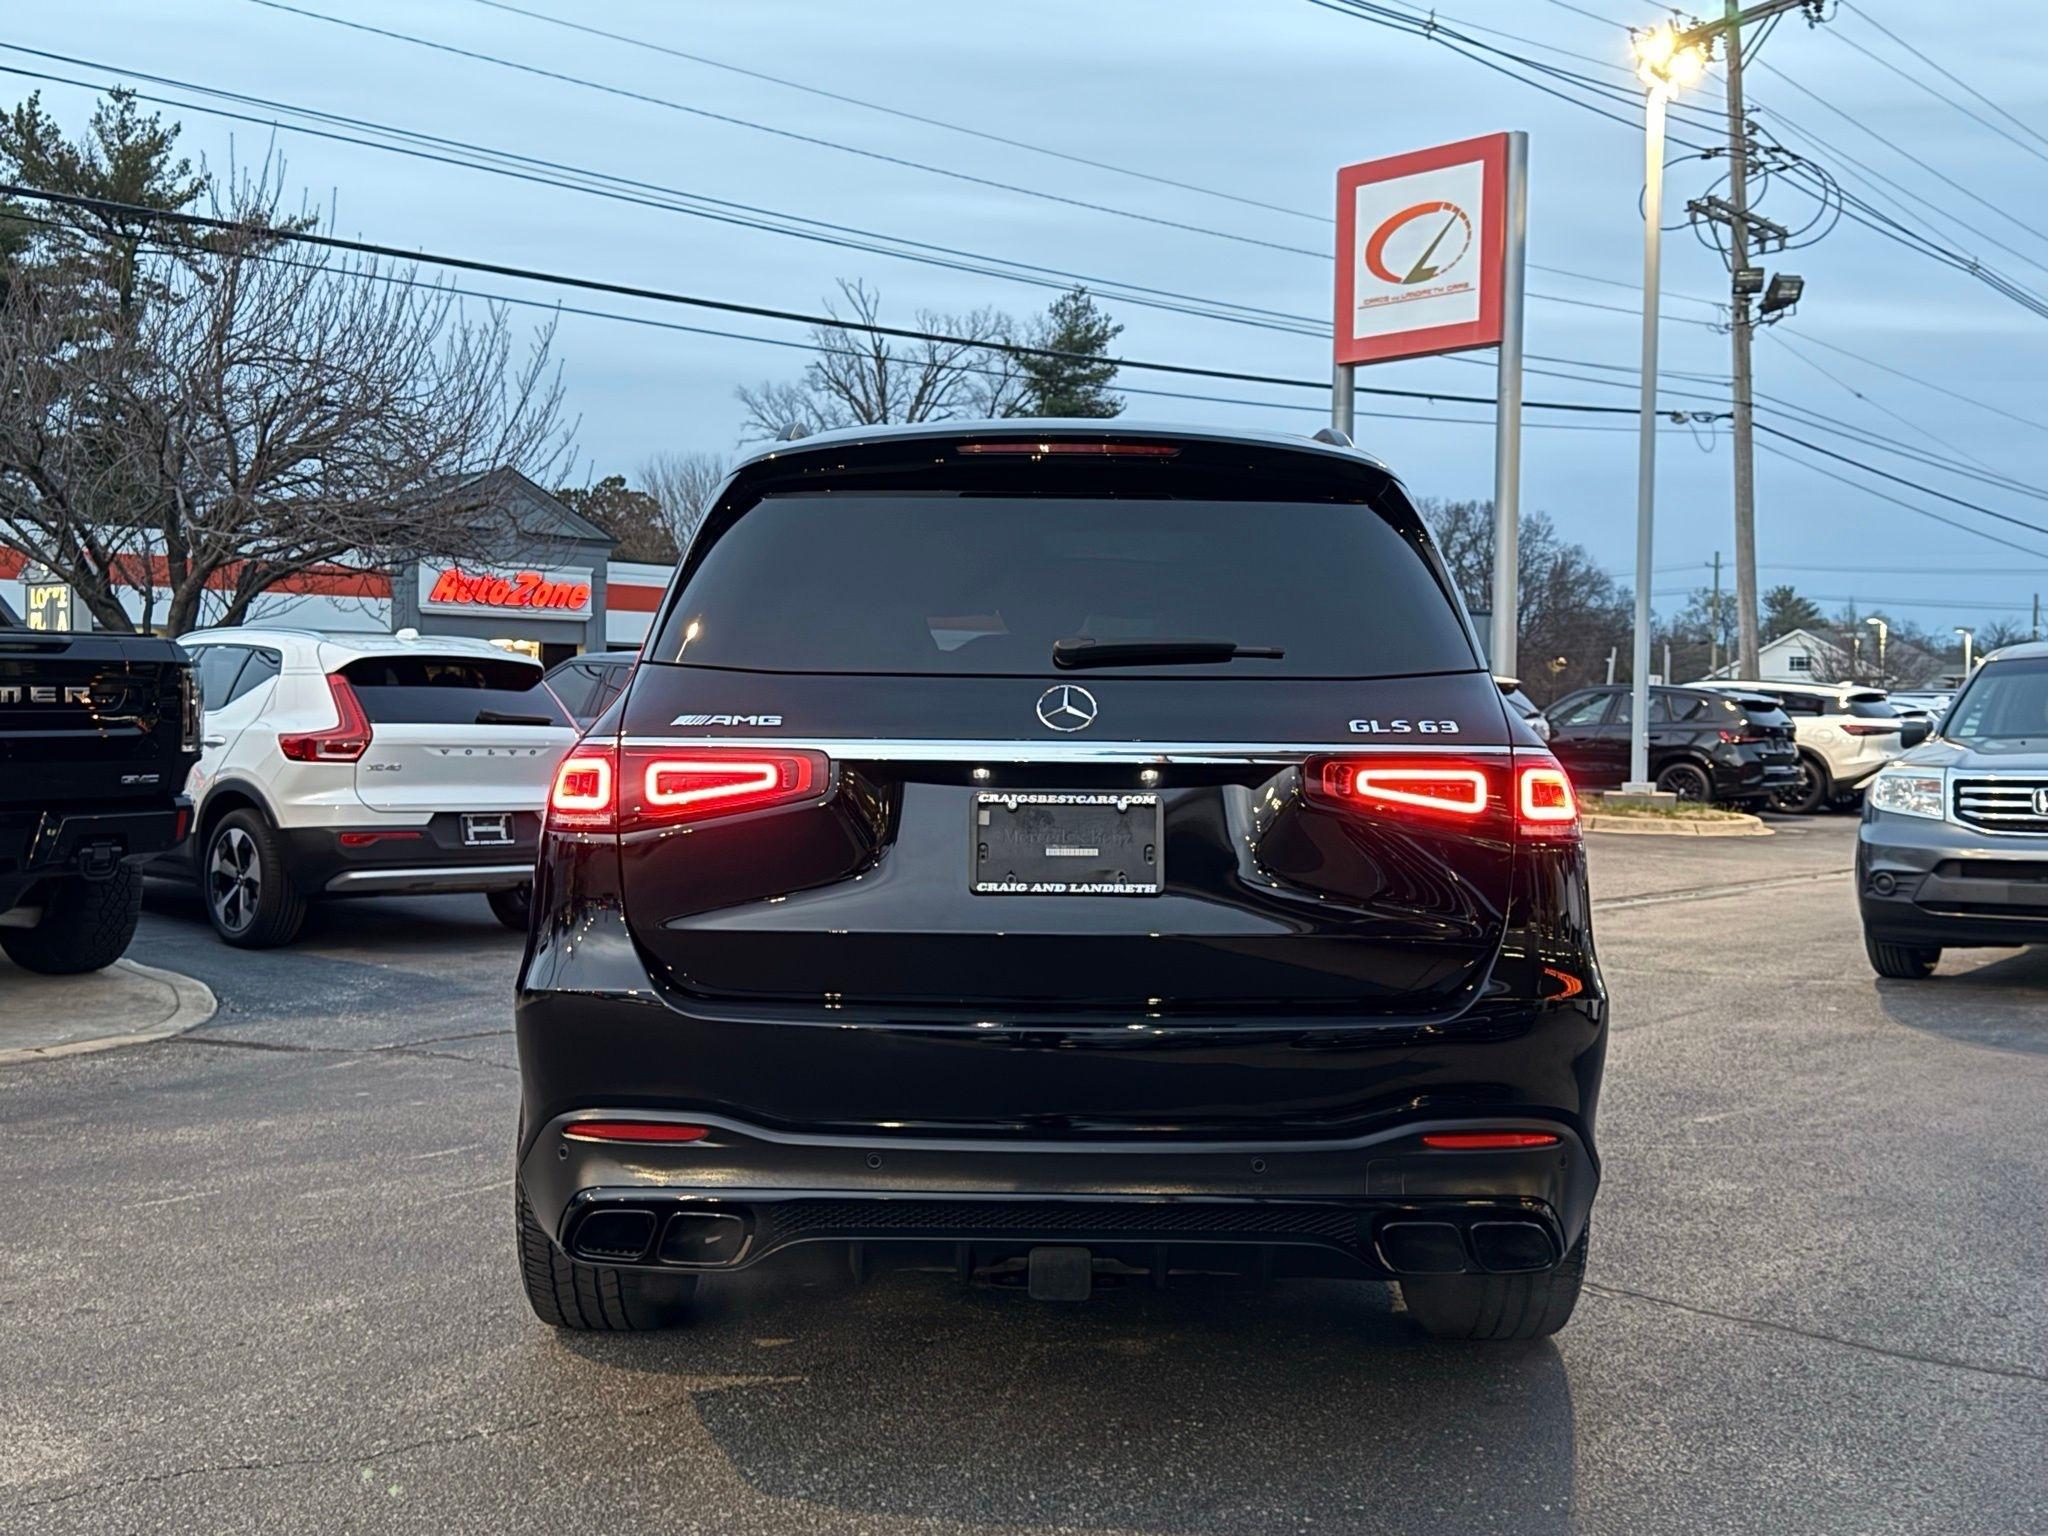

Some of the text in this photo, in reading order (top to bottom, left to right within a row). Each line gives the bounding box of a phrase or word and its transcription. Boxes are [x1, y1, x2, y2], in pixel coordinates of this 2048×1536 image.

[429, 567, 591, 609] AutoZone
[1349, 719, 1459, 734] GLS 63
[440, 749, 537, 757] VOLVO
[976, 882, 1157, 894] CRAIG AND LANDRETH
